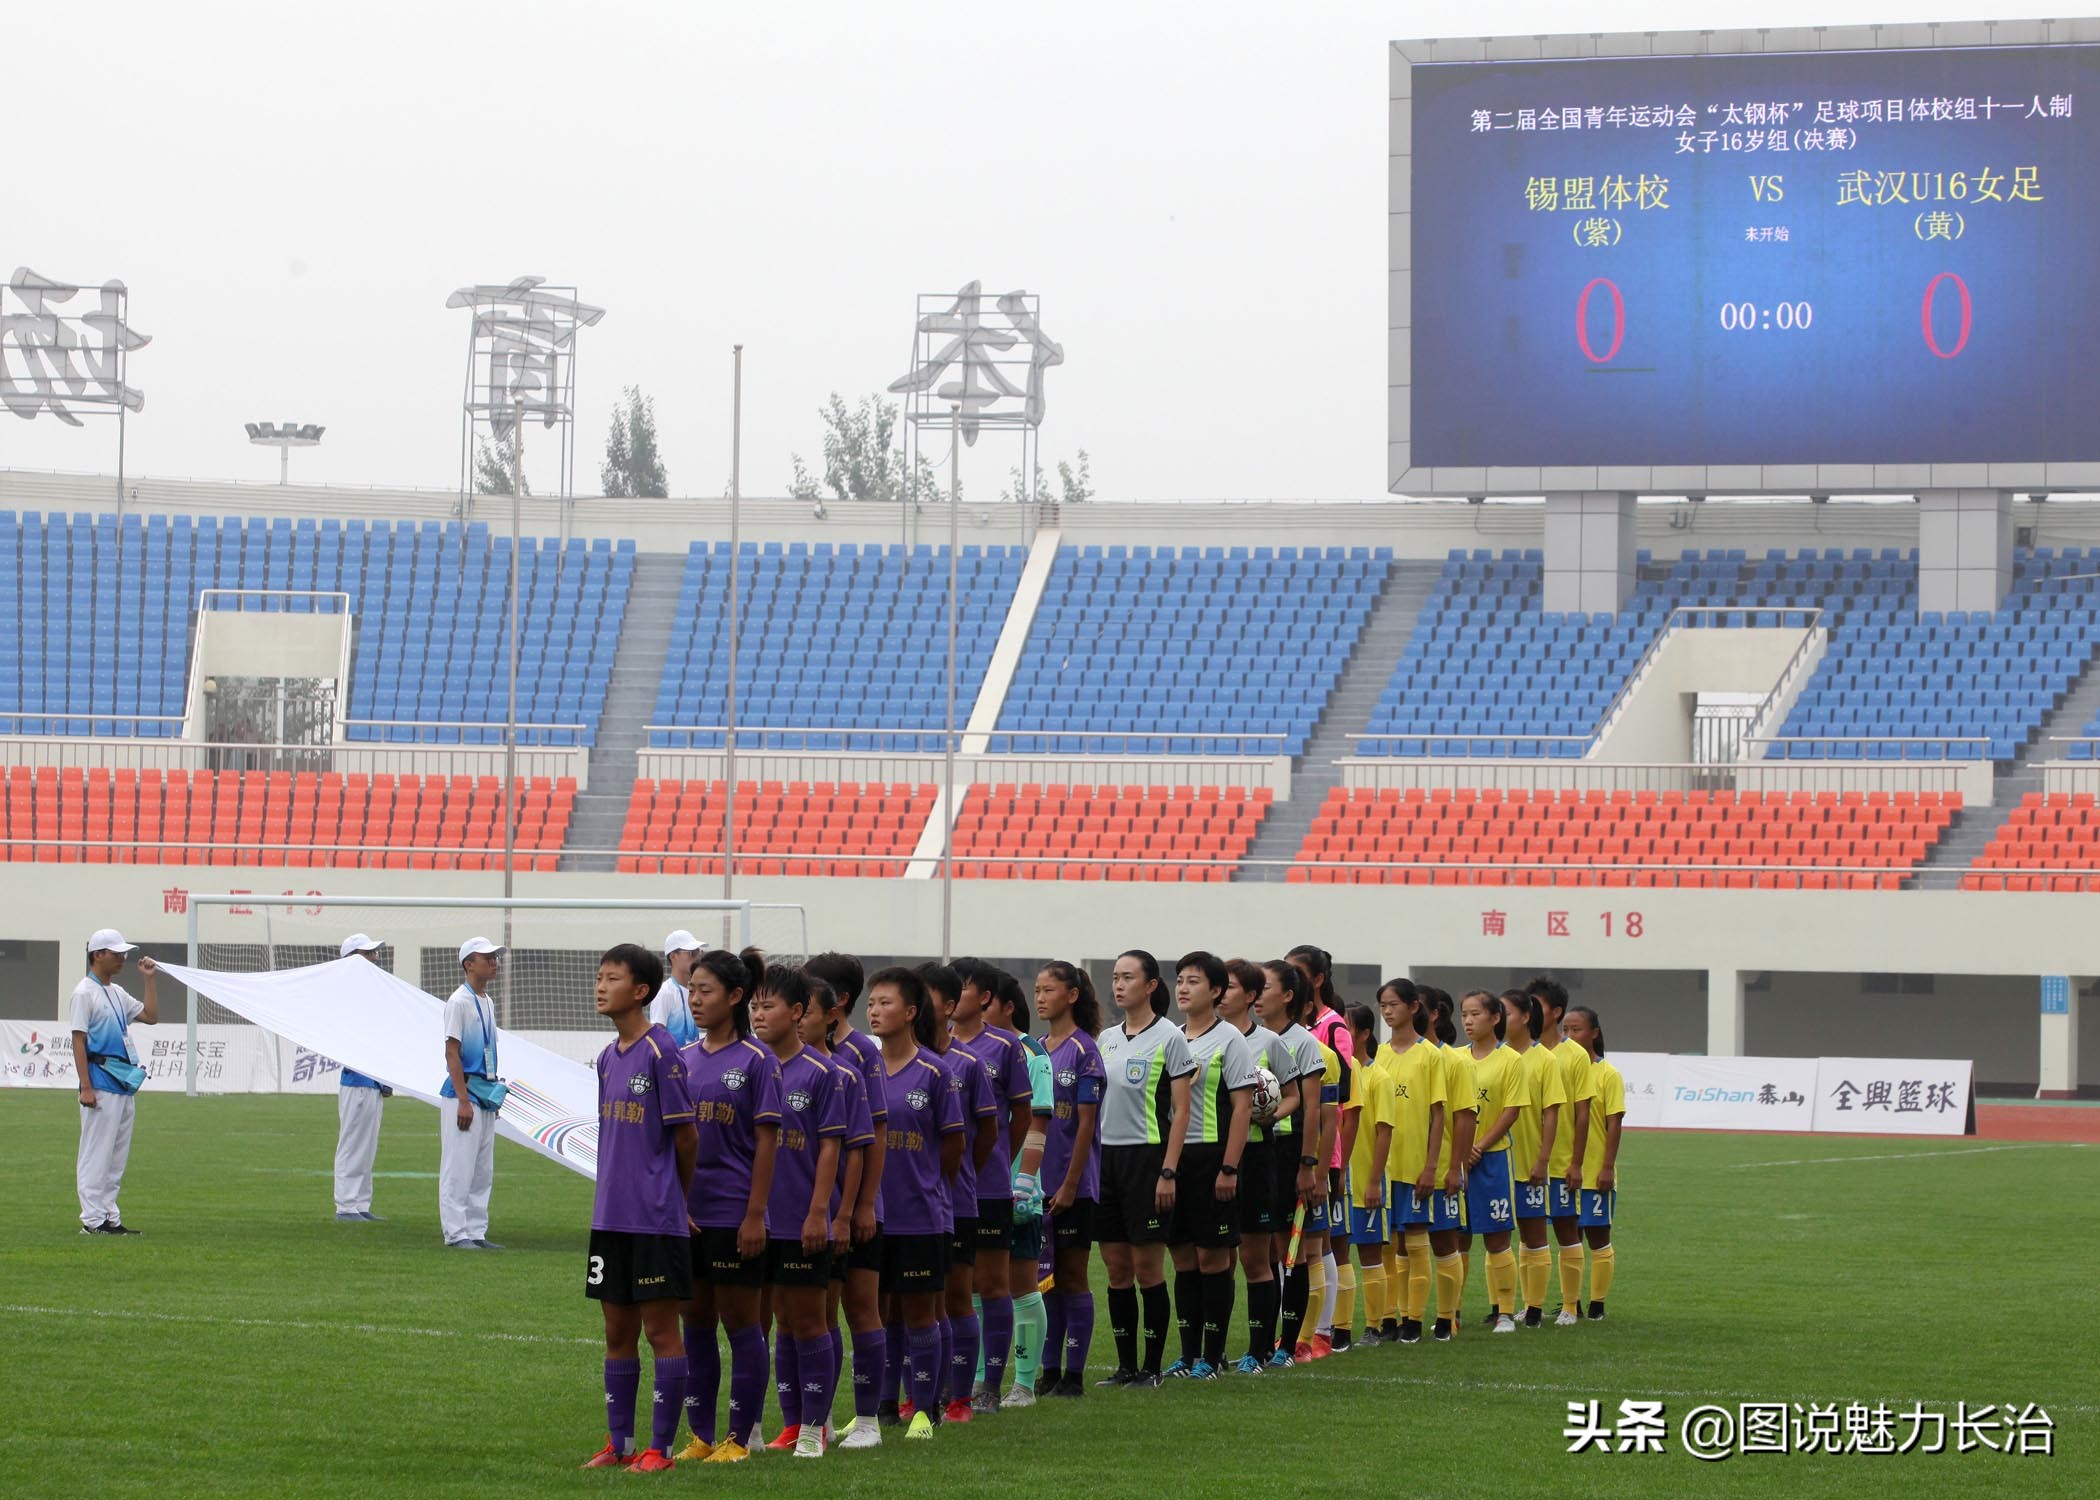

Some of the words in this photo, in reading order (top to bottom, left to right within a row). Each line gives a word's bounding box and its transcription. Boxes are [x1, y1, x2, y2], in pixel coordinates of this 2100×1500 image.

[1525, 174, 1670, 212] 锡盟体校
[1749, 176, 1785, 202] VS
[1836, 166, 2045, 206] 武汉U16女足
[1573, 217, 1623, 247] (紫)
[1745, 227, 1790, 242] 未开始
[1914, 211, 1965, 241] (黄)
[1576, 277, 1625, 363] 0
[1720, 302, 1813, 330] 00:00
[1921, 272, 1972, 358] 0
[1395, 1084, 1409, 1099] 汉
[1477, 1088, 1490, 1102] 汉
[1674, 1086, 1755, 1103] TaiShan
[1526, 1185, 1544, 1205] 33
[1559, 1184, 1569, 1204] 5
[1592, 1194, 1603, 1214] 2
[1443, 1195, 1459, 1217] 15
[1489, 1198, 1510, 1220] 32
[587, 1255, 605, 1286] 3
[712, 1261, 742, 1269] KELME
[903, 1270, 931, 1278] KELME
[638, 1276, 666, 1285] KELME
